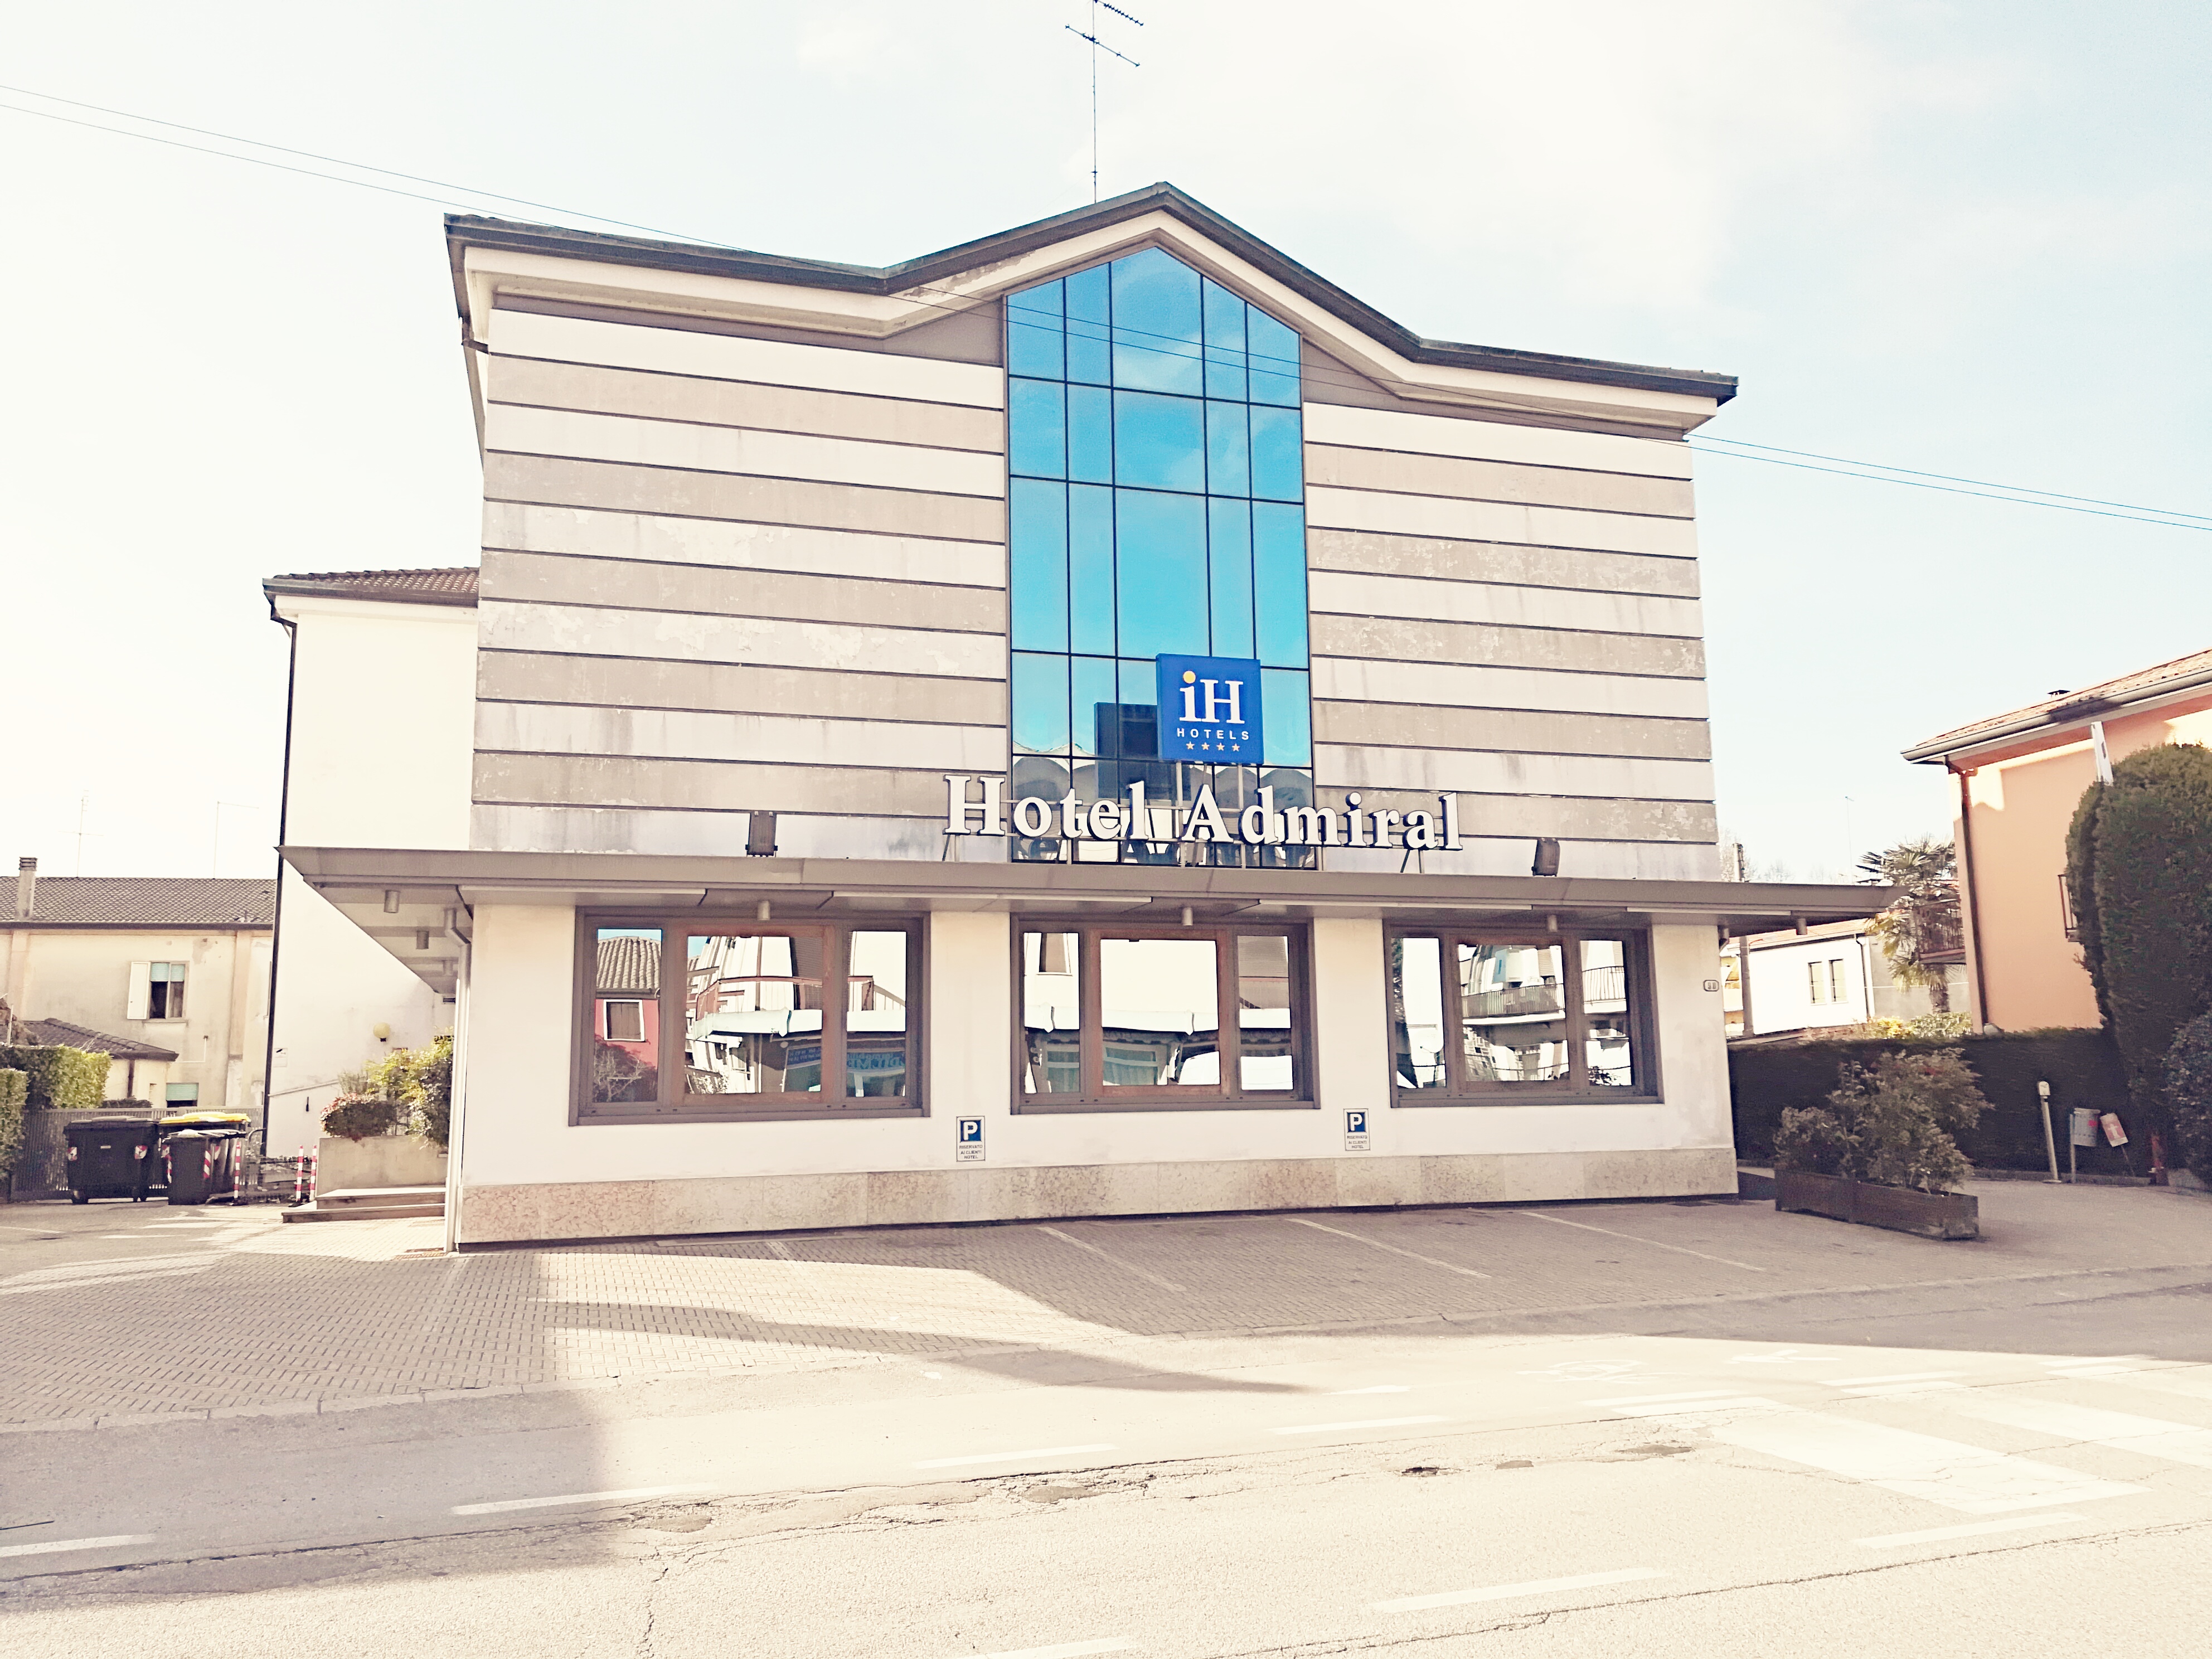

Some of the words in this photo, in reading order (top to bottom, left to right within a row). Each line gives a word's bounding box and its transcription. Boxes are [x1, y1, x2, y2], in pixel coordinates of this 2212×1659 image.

[1179, 670, 1245, 724] iH
[1177, 727, 1249, 740] HOTELS
[943, 774, 1149, 841] Hotel
[1181, 784, 1463, 851] Admiral
[963, 1121, 978, 1141] P
[1350, 1113, 1362, 1131] P
